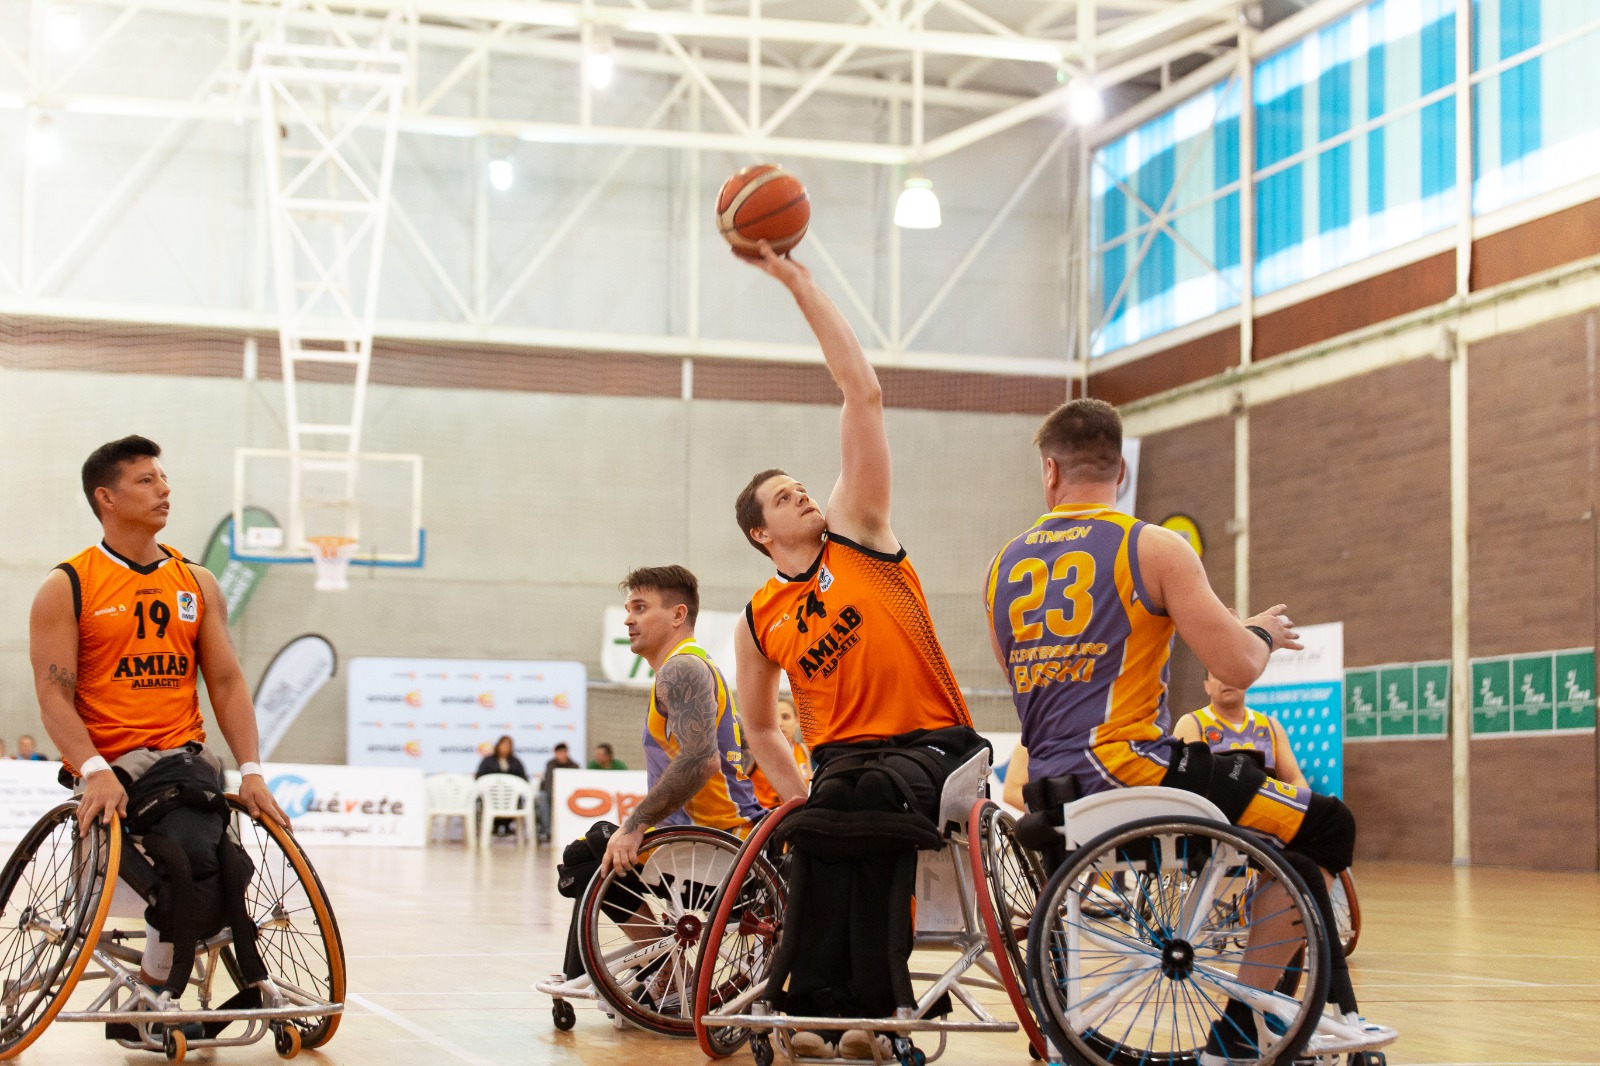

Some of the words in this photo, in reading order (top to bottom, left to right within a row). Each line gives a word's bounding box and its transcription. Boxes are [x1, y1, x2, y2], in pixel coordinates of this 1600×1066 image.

[134, 600, 170, 639] 19
[1008, 551, 1096, 643] 23
[114, 655, 188, 678] AMIAB
[798, 607, 862, 679] AMIAB
